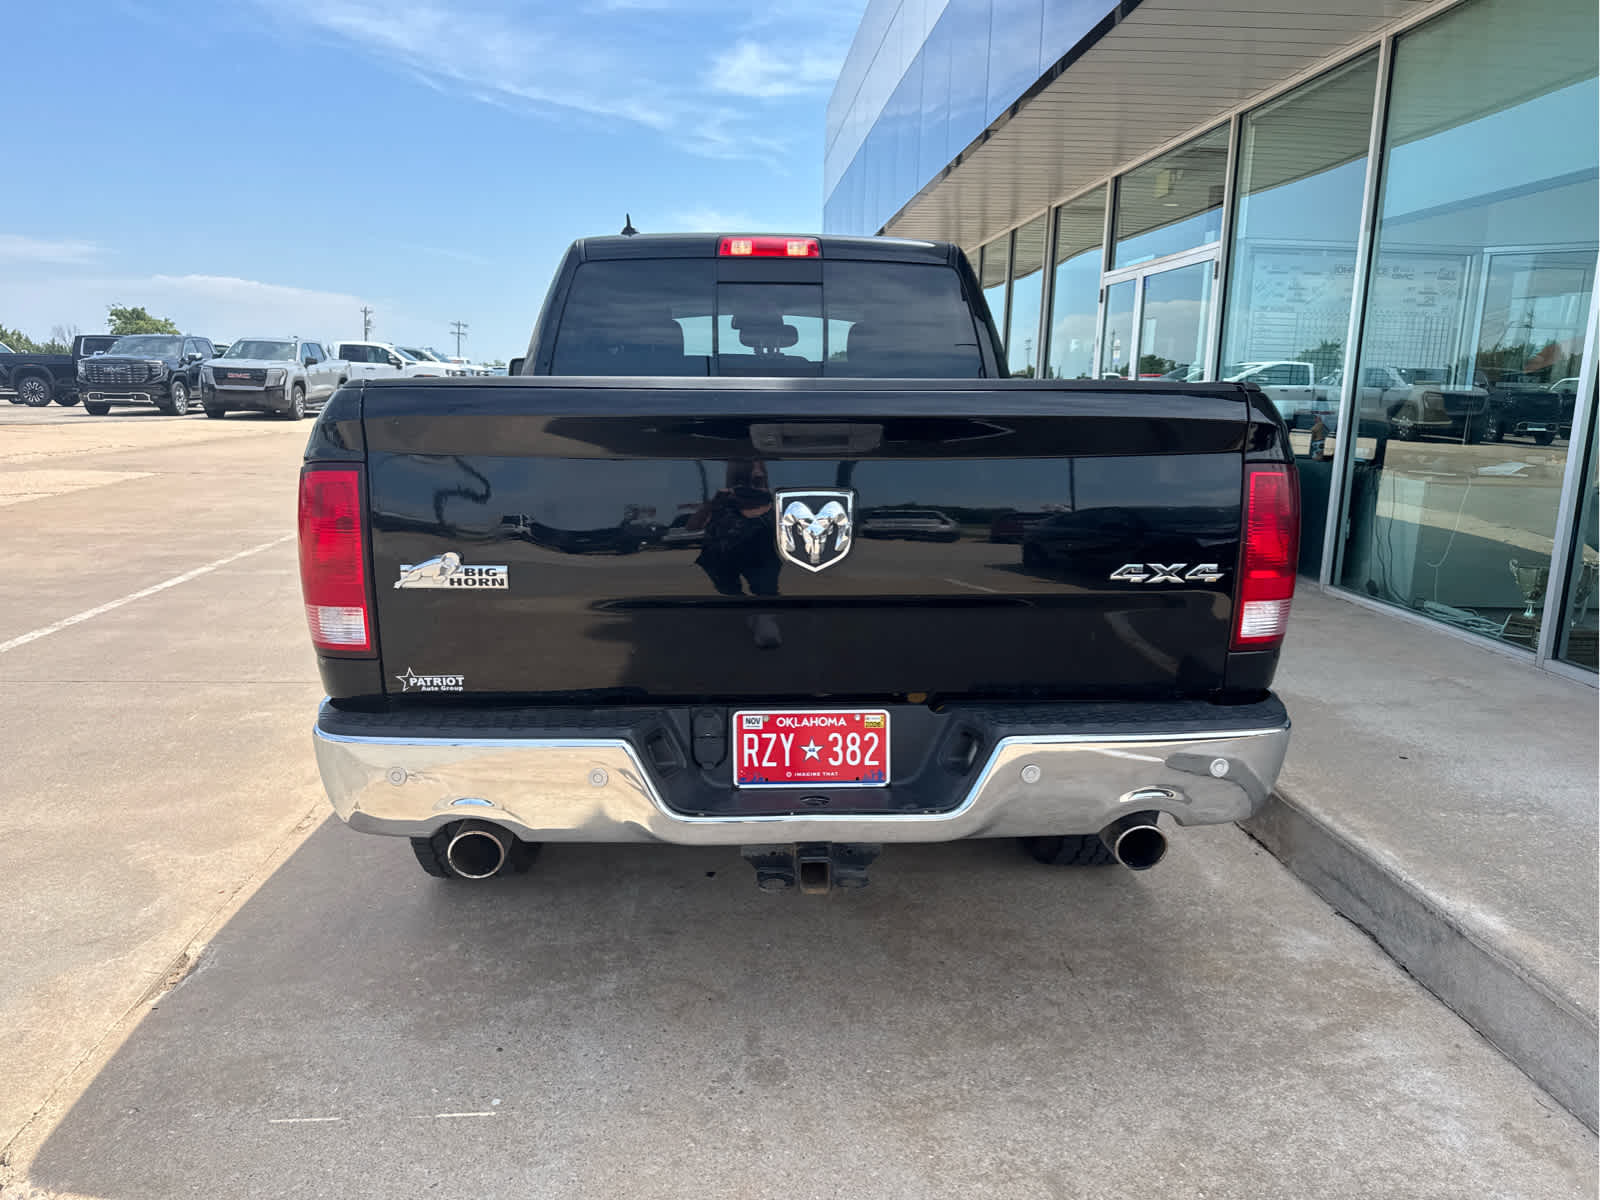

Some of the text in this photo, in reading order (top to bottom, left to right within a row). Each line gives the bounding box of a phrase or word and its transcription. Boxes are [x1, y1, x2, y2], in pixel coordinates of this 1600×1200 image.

[464, 568, 497, 577] BIG
[449, 578, 505, 586] HORN
[409, 677, 465, 686] PATRIOT
[745, 717, 761, 725] NOV
[776, 717, 847, 729] OKLAHOMA
[743, 732, 880, 767] RZY 382
